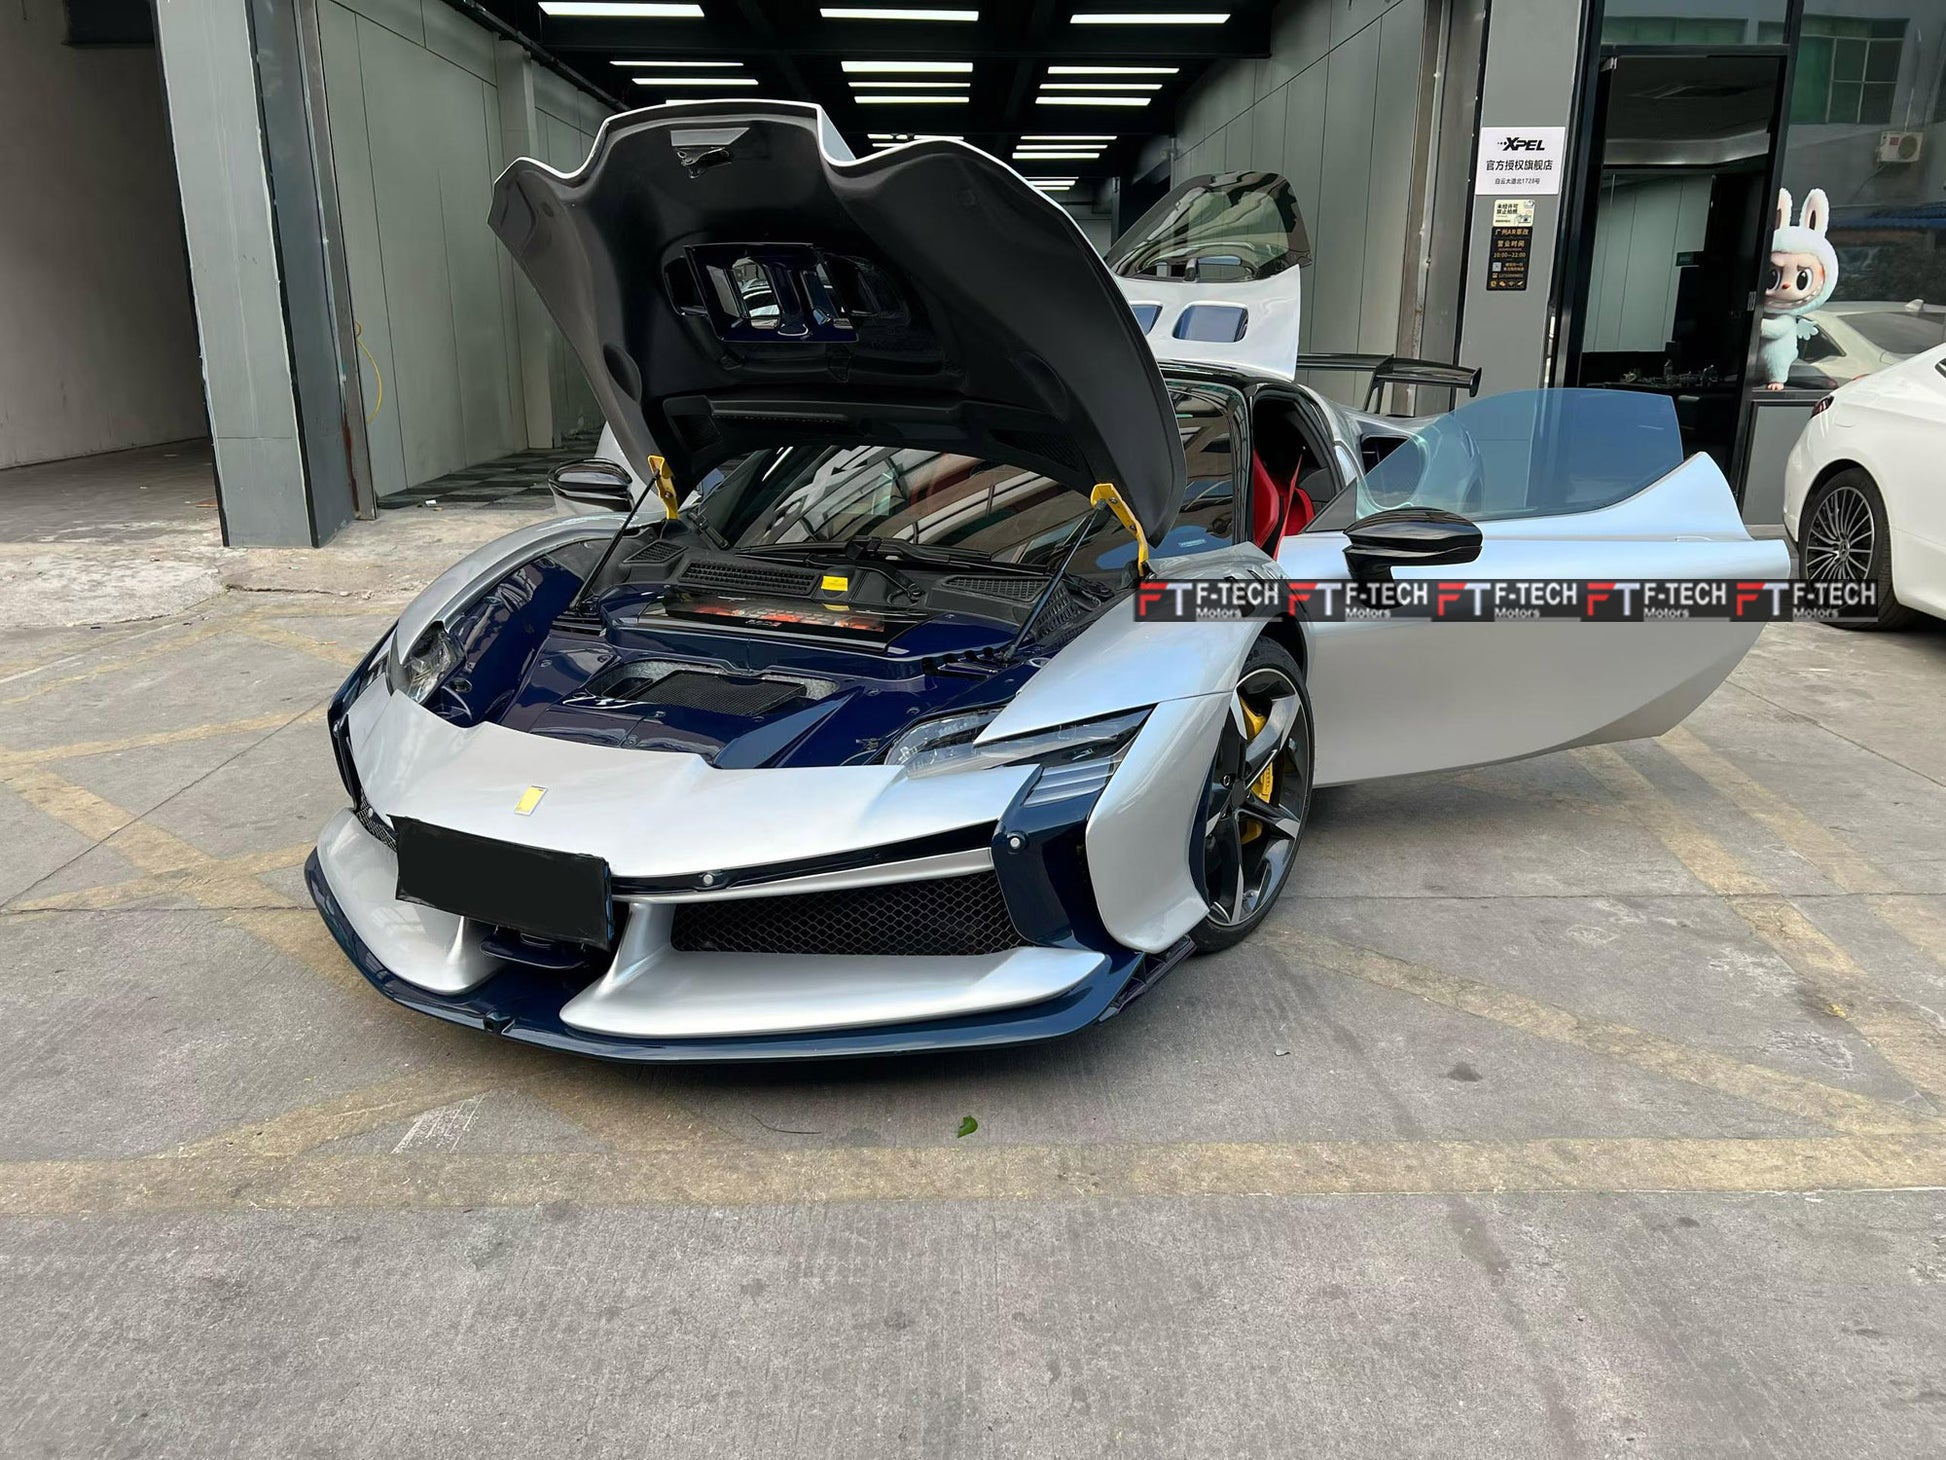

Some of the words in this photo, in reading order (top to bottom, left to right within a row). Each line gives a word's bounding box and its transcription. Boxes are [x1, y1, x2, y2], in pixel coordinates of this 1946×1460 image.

[1503, 137, 1545, 151] XPEL
[1486, 159, 1553, 171] 官方授权旗舰店
